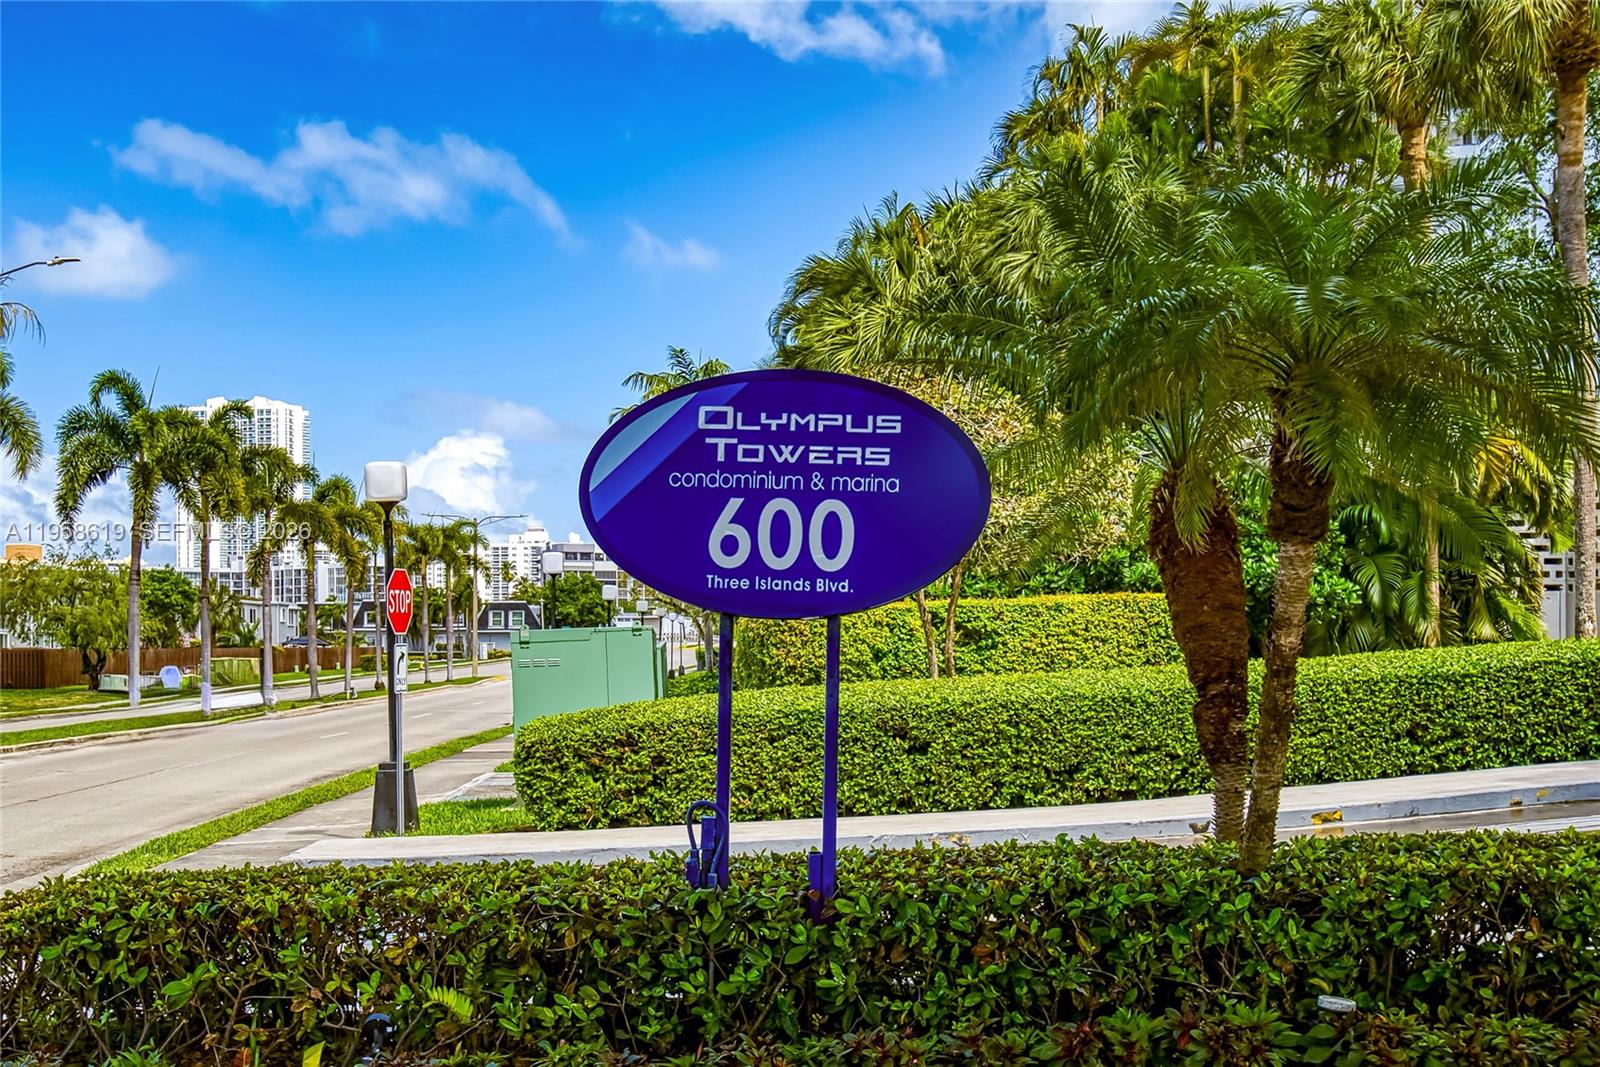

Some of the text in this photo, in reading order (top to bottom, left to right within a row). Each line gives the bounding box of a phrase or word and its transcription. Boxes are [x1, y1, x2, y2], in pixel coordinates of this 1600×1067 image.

[668, 470, 900, 493] condominium & marina
[708, 497, 855, 573] 600
[706, 574, 855, 594] Three Islands Blvd.
[388, 589, 411, 613] STOP
